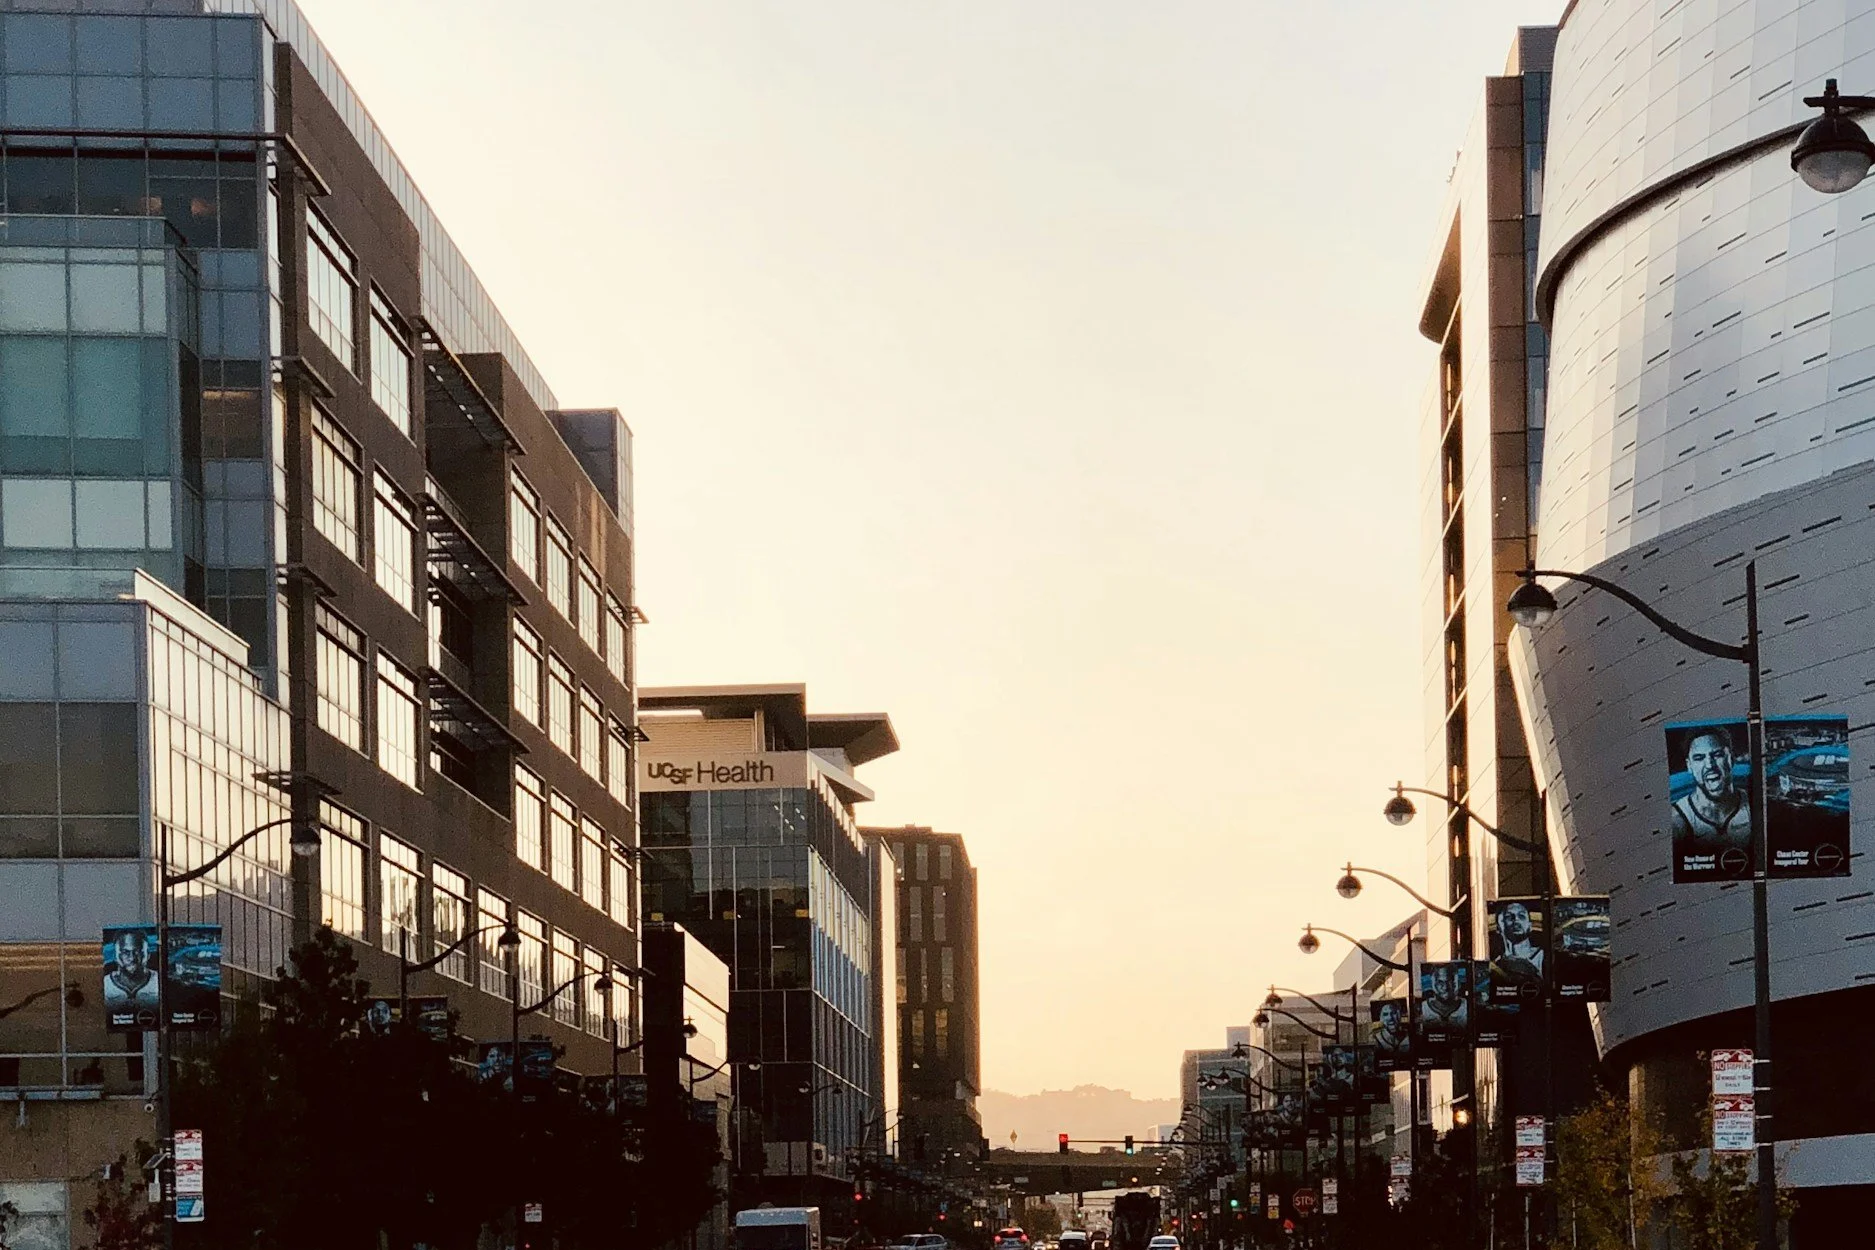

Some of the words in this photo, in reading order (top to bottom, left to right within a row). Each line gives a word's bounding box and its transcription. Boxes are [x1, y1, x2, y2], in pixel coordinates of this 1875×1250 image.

[647, 762, 694, 785] UCSF
[697, 760, 774, 784] Health
[1714, 1061, 1725, 1070] NO
[1715, 1110, 1725, 1118] NO
